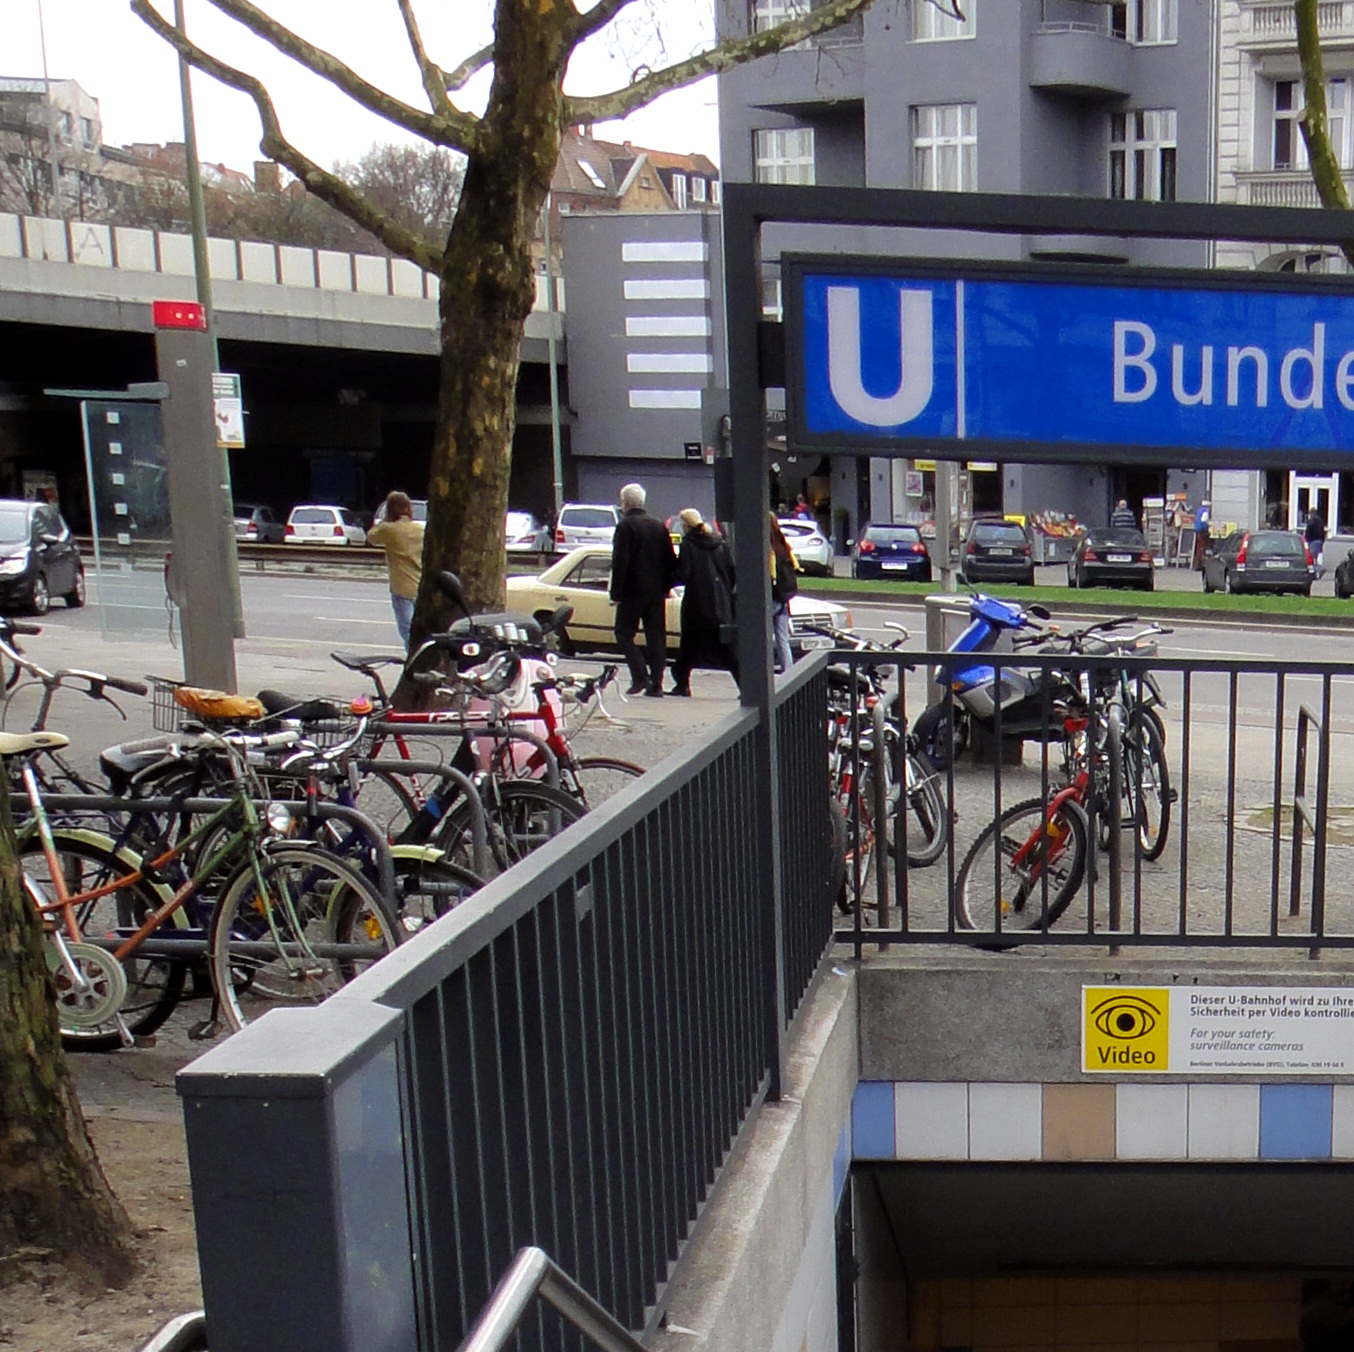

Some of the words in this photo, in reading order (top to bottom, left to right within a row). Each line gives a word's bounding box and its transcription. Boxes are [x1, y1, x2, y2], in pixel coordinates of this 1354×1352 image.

[828, 286, 934, 427] U
[1190, 994, 1225, 1006] Dieser
[1228, 995, 1287, 1006] U-Bahnhof
[1289, 995, 1314, 1006] wird
[1317, 998, 1330, 1006] zu
[1190, 1006, 1245, 1017] Sicherheit
[1248, 1009, 1266, 1019] per
[1270, 1007, 1301, 1018] Video
[1190, 1028, 1208, 1039] For
[1211, 1030, 1236, 1041] your
[1190, 1040, 1256, 1051] surveillance
[1258, 1042, 1304, 1052] cameras
[1097, 1046, 1156, 1064] Video
